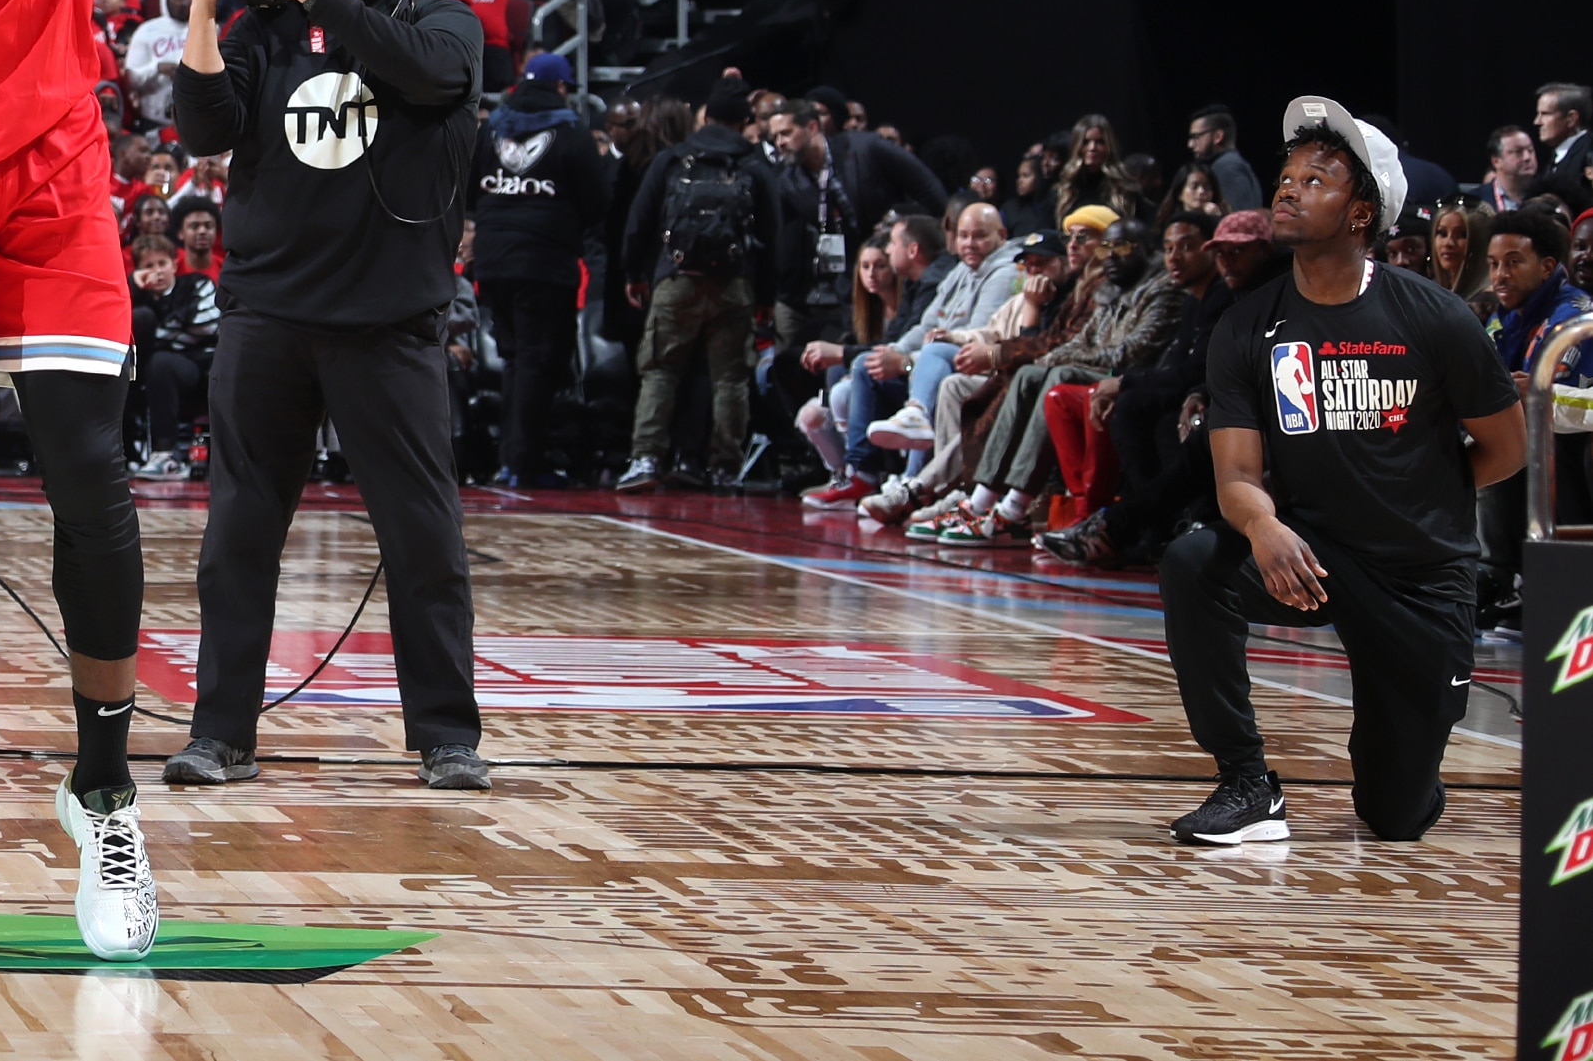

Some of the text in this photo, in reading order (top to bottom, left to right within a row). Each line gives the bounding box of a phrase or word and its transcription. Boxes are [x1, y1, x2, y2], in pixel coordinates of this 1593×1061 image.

[284, 99, 379, 144] TNT
[1322, 379, 1418, 412] SATURDAY
[1285, 412, 1304, 429] NBA
[1325, 410, 1404, 430] NIGHT 2020 CHI
